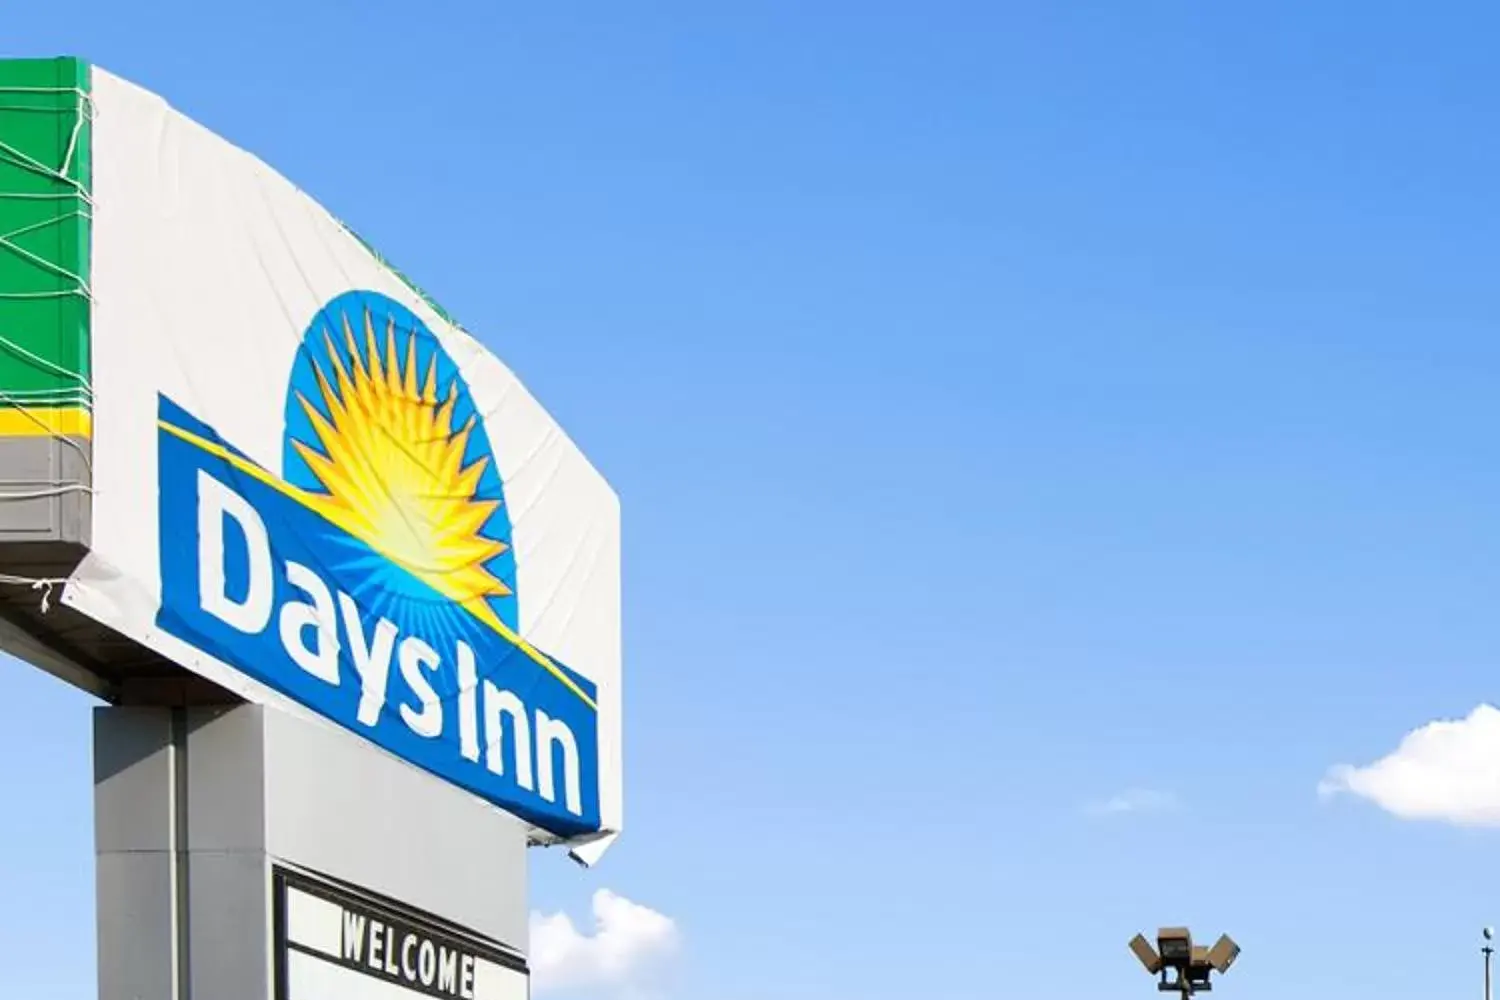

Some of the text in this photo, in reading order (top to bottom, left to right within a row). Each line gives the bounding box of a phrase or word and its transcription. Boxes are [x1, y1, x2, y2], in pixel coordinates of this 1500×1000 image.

[198, 468, 583, 816] Days Inn
[341, 911, 475, 1000] WELCOME
